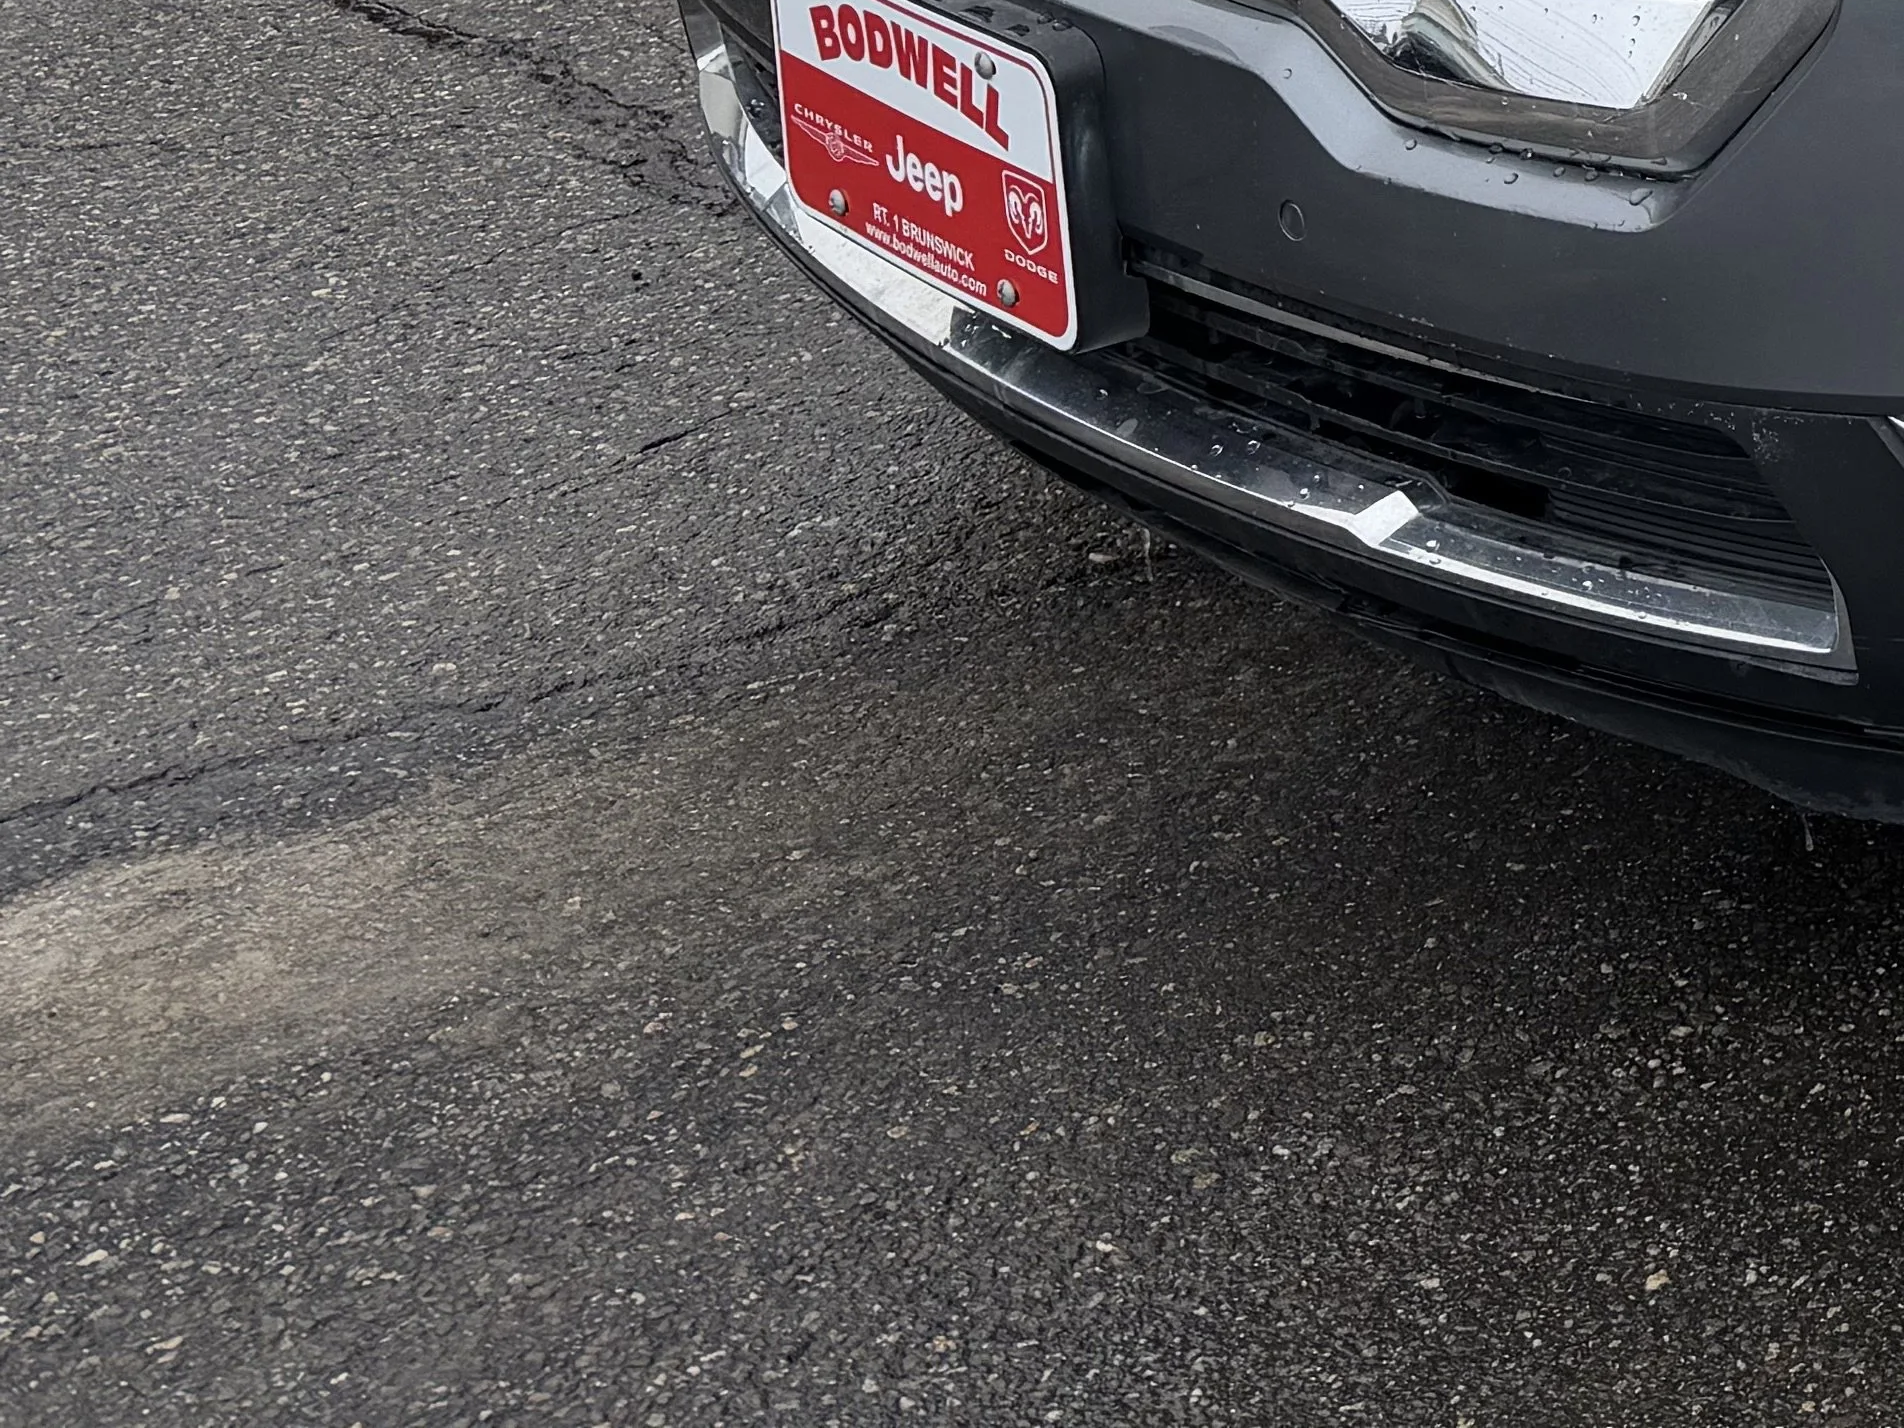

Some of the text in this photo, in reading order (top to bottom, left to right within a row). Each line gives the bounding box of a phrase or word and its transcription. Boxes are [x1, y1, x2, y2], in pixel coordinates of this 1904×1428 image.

[809, 3, 1009, 151] BODWELL
[794, 103, 873, 153] CHRYSLER
[885, 134, 964, 217] Jeep
[865, 221, 987, 296] www.bodwellauto.com
[873, 202, 975, 271] RT. 1 BRUNSWICK
[1003, 248, 1059, 284] DODGE
